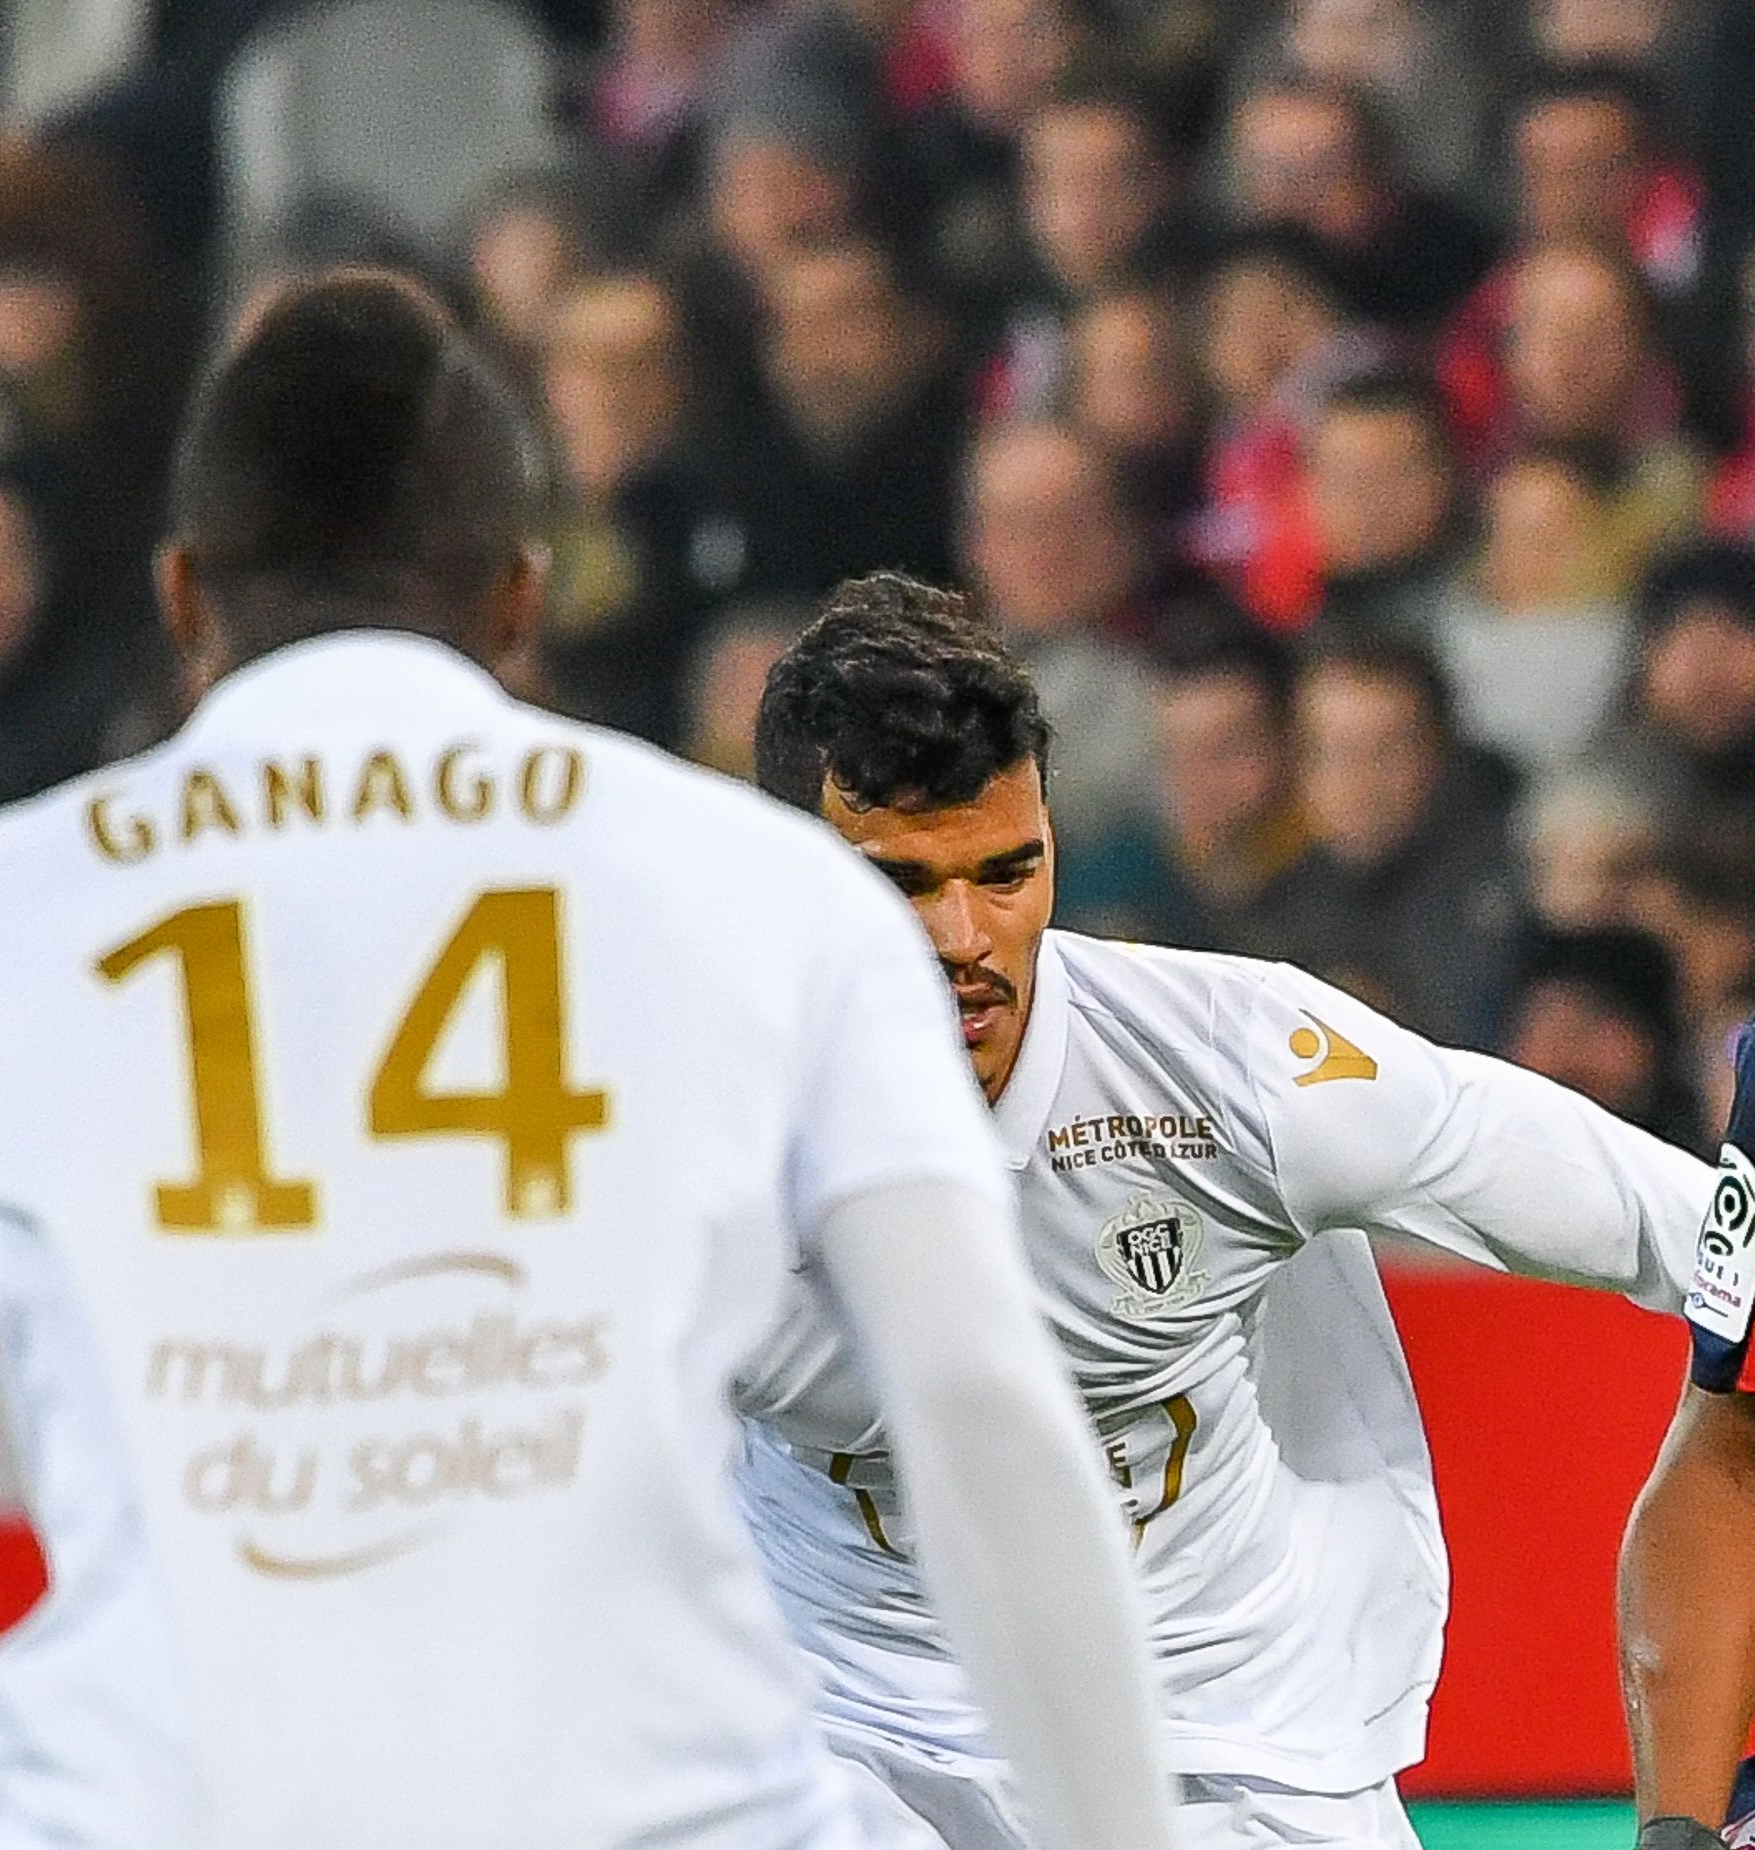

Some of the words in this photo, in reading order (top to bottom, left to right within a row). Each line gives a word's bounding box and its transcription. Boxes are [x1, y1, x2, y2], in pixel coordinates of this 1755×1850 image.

[86, 742, 586, 862] GANAGO
[96, 884, 609, 1234] 14
[1048, 1114, 1214, 1152] MÉTROPOLE
[1051, 1149, 1097, 1173] NICE
[142, 1308, 611, 1412] mutuelles
[178, 1425, 321, 1516] du
[342, 1404, 583, 1516] soleil
